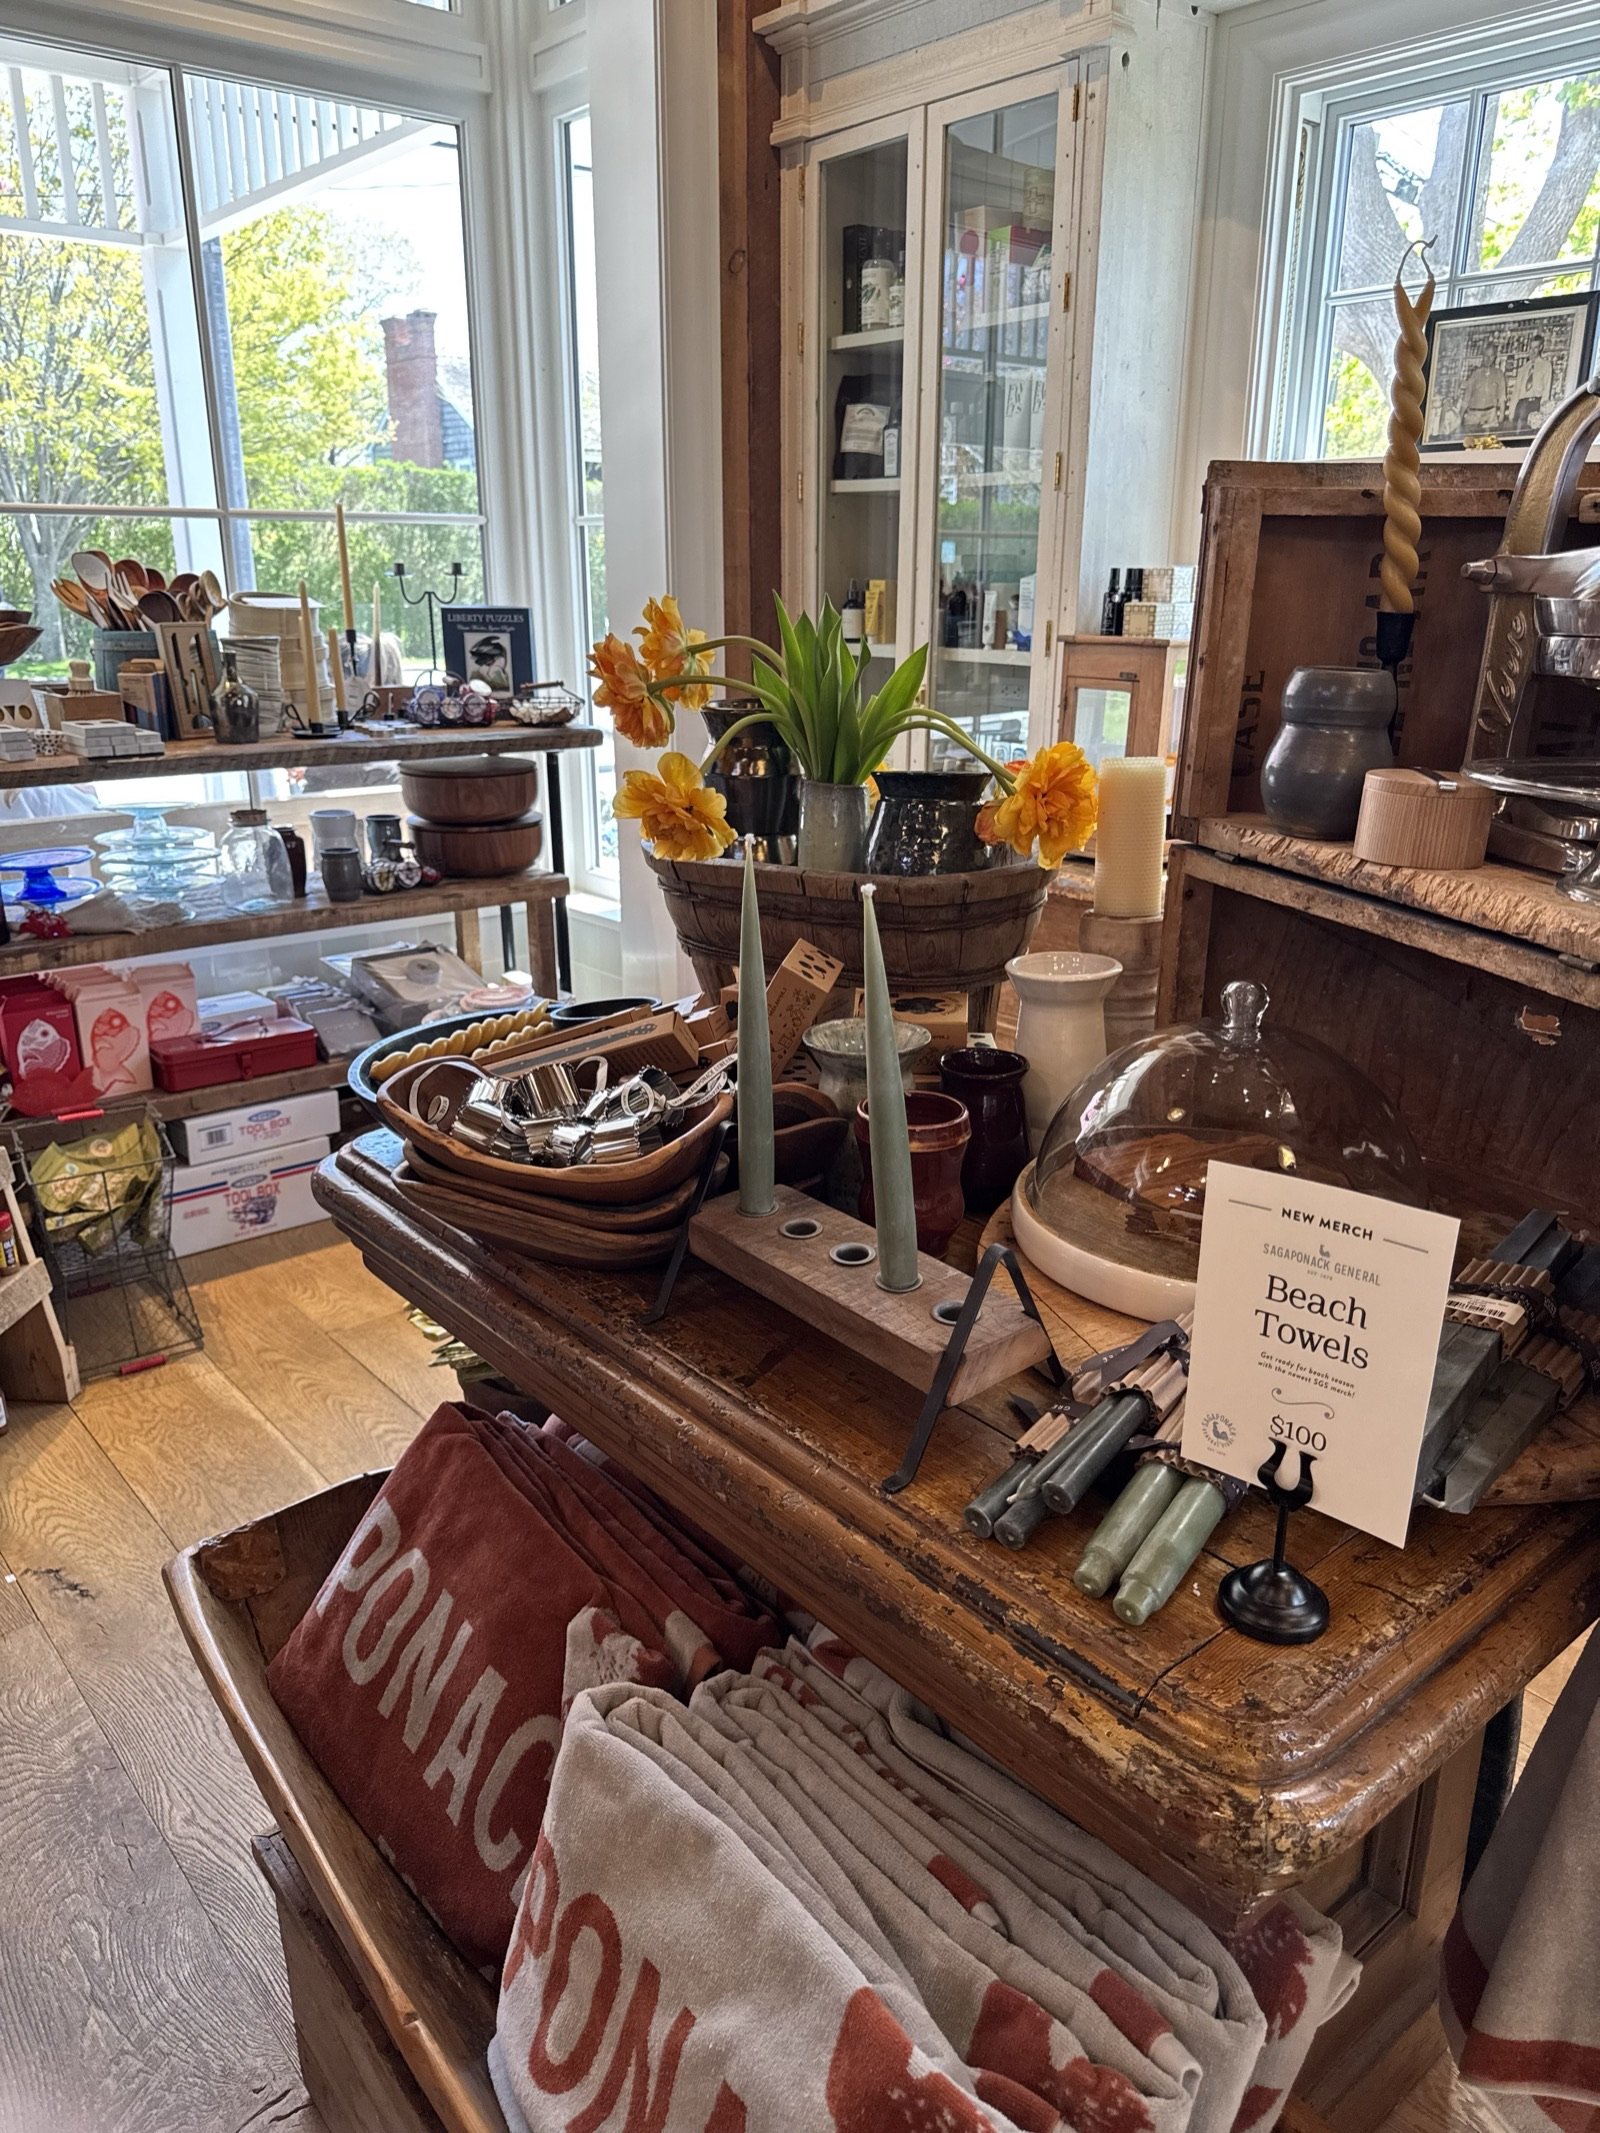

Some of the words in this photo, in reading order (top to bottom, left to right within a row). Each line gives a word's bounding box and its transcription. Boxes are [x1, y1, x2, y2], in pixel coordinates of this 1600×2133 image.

[447, 613, 484, 622] LIBERTY
[485, 614, 524, 623] PUZZLES
[239, 1122, 267, 1137] TOOL
[270, 1116, 292, 1129] BOX
[223, 1189, 254, 1206] TOOL
[256, 1182, 282, 1199] BOX
[1281, 1207, 1315, 1225] NEW
[1319, 1217, 1373, 1241] MERCH
[1263, 1243, 1331, 1271] SAGAPONACK
[1334, 1262, 1381, 1287] GENERAL
[1265, 1274, 1367, 1330] Beach
[1254, 1308, 1369, 1369] Towels
[1258, 1361, 1273, 1370] with
[1275, 1365, 1286, 1374] the
[1288, 1371, 1311, 1383] newest
[1313, 1378, 1329, 1389] SGS
[1330, 1385, 1355, 1399] merch!
[1260, 1351, 1273, 1361] Get
[1275, 1357, 1294, 1369] ready
[1296, 1363, 1307, 1372] for
[1308, 1367, 1329, 1379] beach
[1331, 1377, 1355, 1389] season
[1270, 1414, 1327, 1452] $100
[316, 1497, 562, 1906] PONAC
